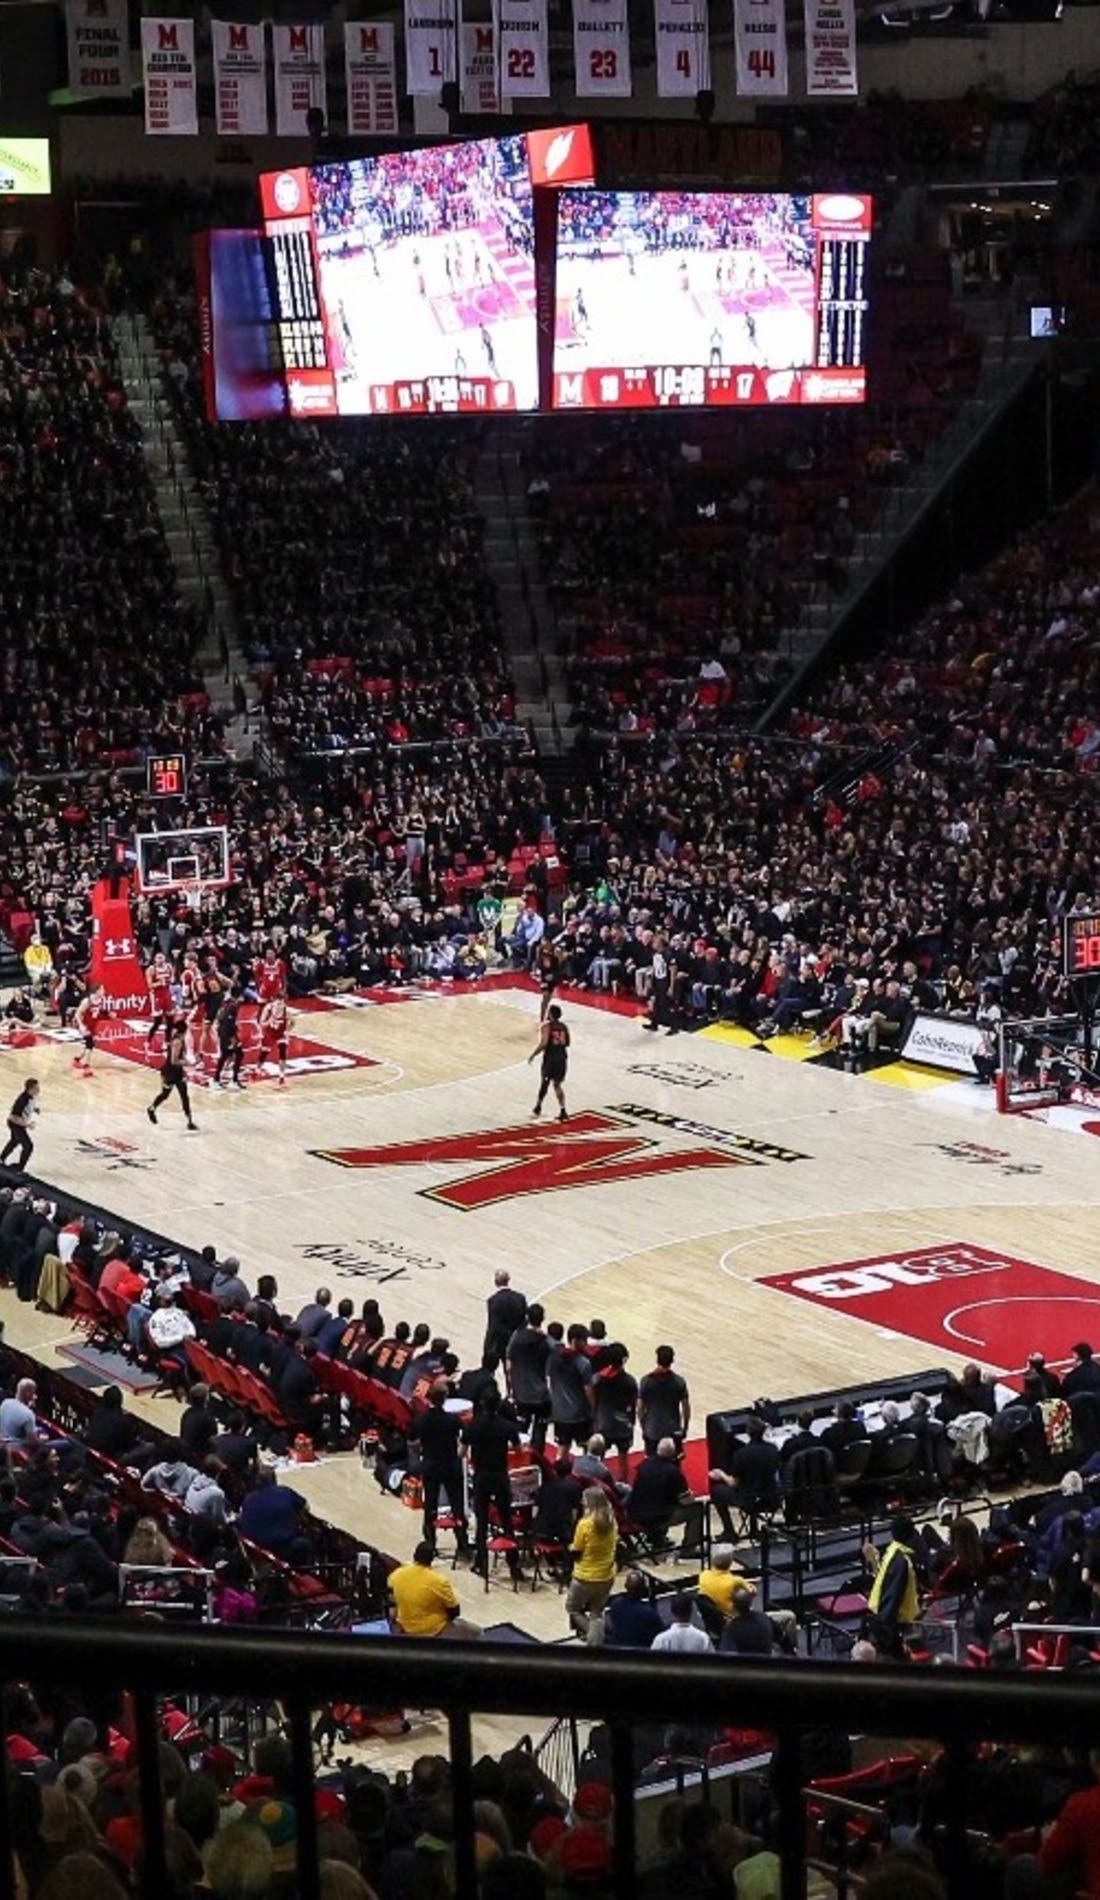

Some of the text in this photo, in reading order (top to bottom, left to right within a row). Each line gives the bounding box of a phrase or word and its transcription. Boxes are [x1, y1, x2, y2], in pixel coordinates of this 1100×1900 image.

[76, 28, 119, 41] FINAL
[158, 24, 178, 50] M
[229, 26, 248, 50] M
[290, 26, 308, 51] M
[361, 28, 378, 52] M
[79, 45, 119, 57] FOUR
[428, 47, 442, 76] 1
[507, 49, 535, 78] 22
[80, 68, 120, 85] 2015
[590, 50, 617, 78] 23
[676, 50, 691, 78] 4
[747, 50, 775, 78] 44
[156, 771, 178, 793] 30
[1075, 936, 1100, 969] 30
